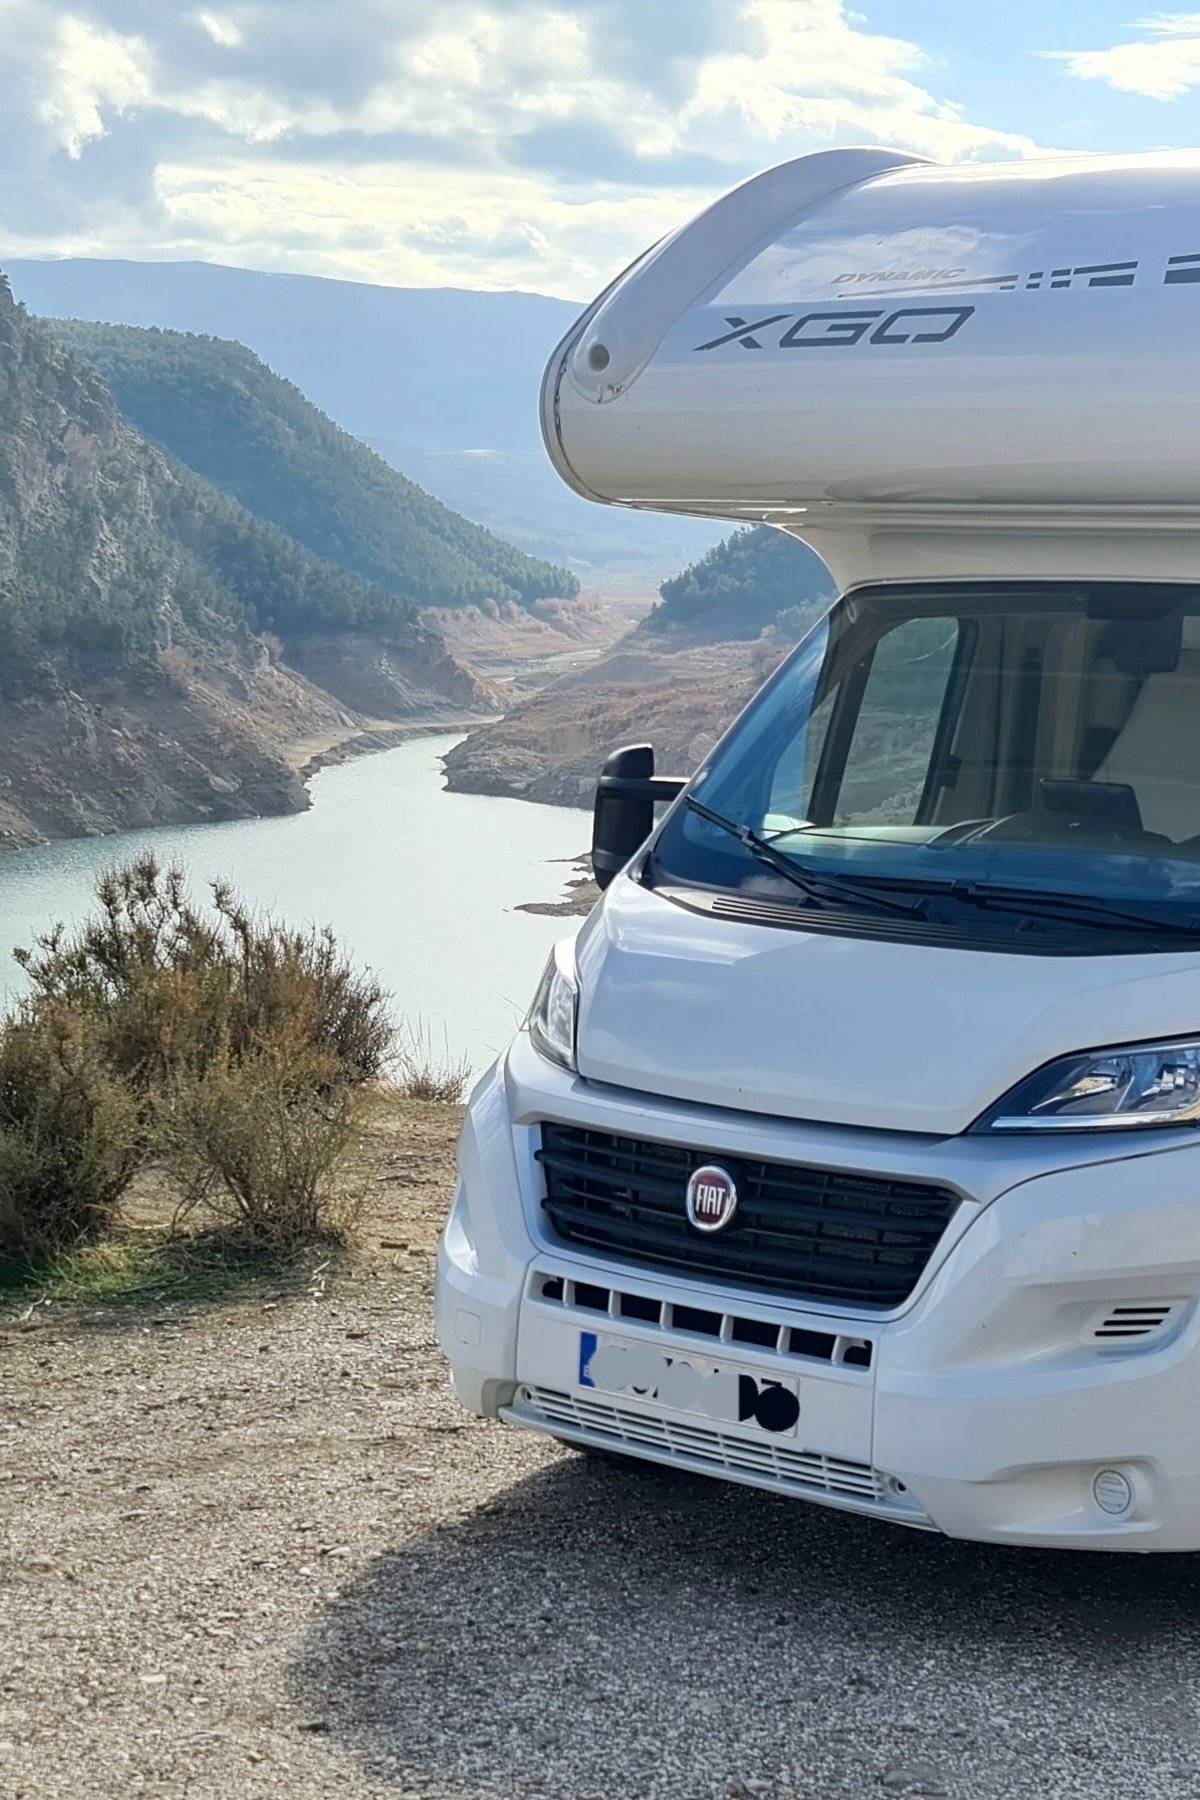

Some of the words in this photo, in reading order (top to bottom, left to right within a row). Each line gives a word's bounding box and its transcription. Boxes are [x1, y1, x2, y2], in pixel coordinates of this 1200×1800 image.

[831, 268, 966, 284] DYNAMIC
[692, 306, 976, 351] XGO
[695, 1184, 726, 1215] FIAT
